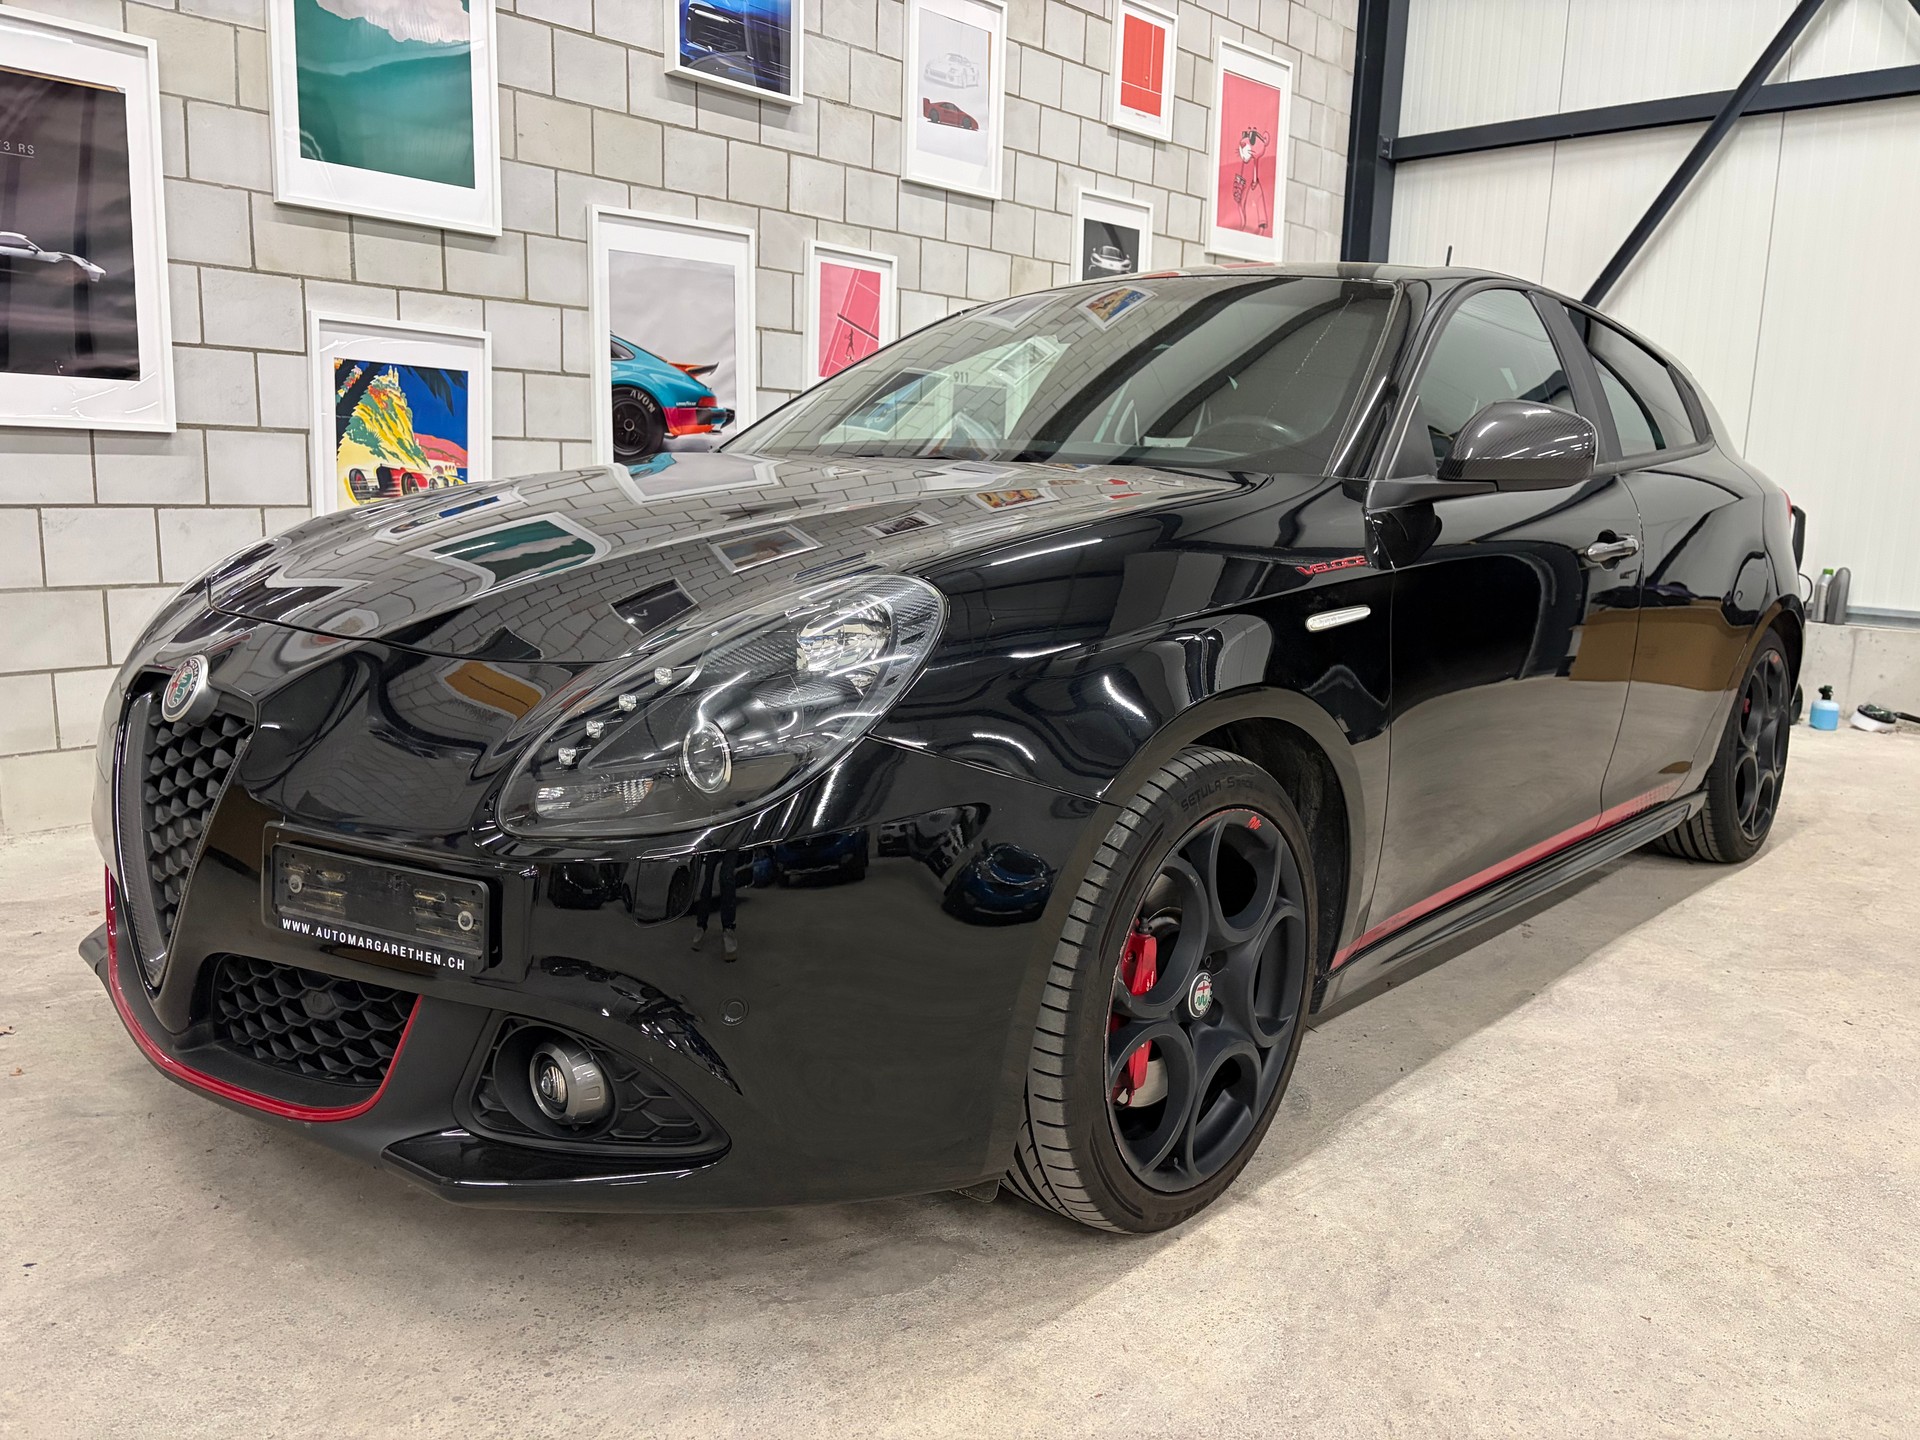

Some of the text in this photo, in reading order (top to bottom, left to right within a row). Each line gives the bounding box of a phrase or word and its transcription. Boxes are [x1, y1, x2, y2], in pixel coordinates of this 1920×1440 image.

[18, 143, 35, 155] RS
[953, 370, 969, 383] 911
[629, 389, 656, 413] AVON
[282, 918, 465, 971] WWW.AUTOMARGARETHEN.CH
